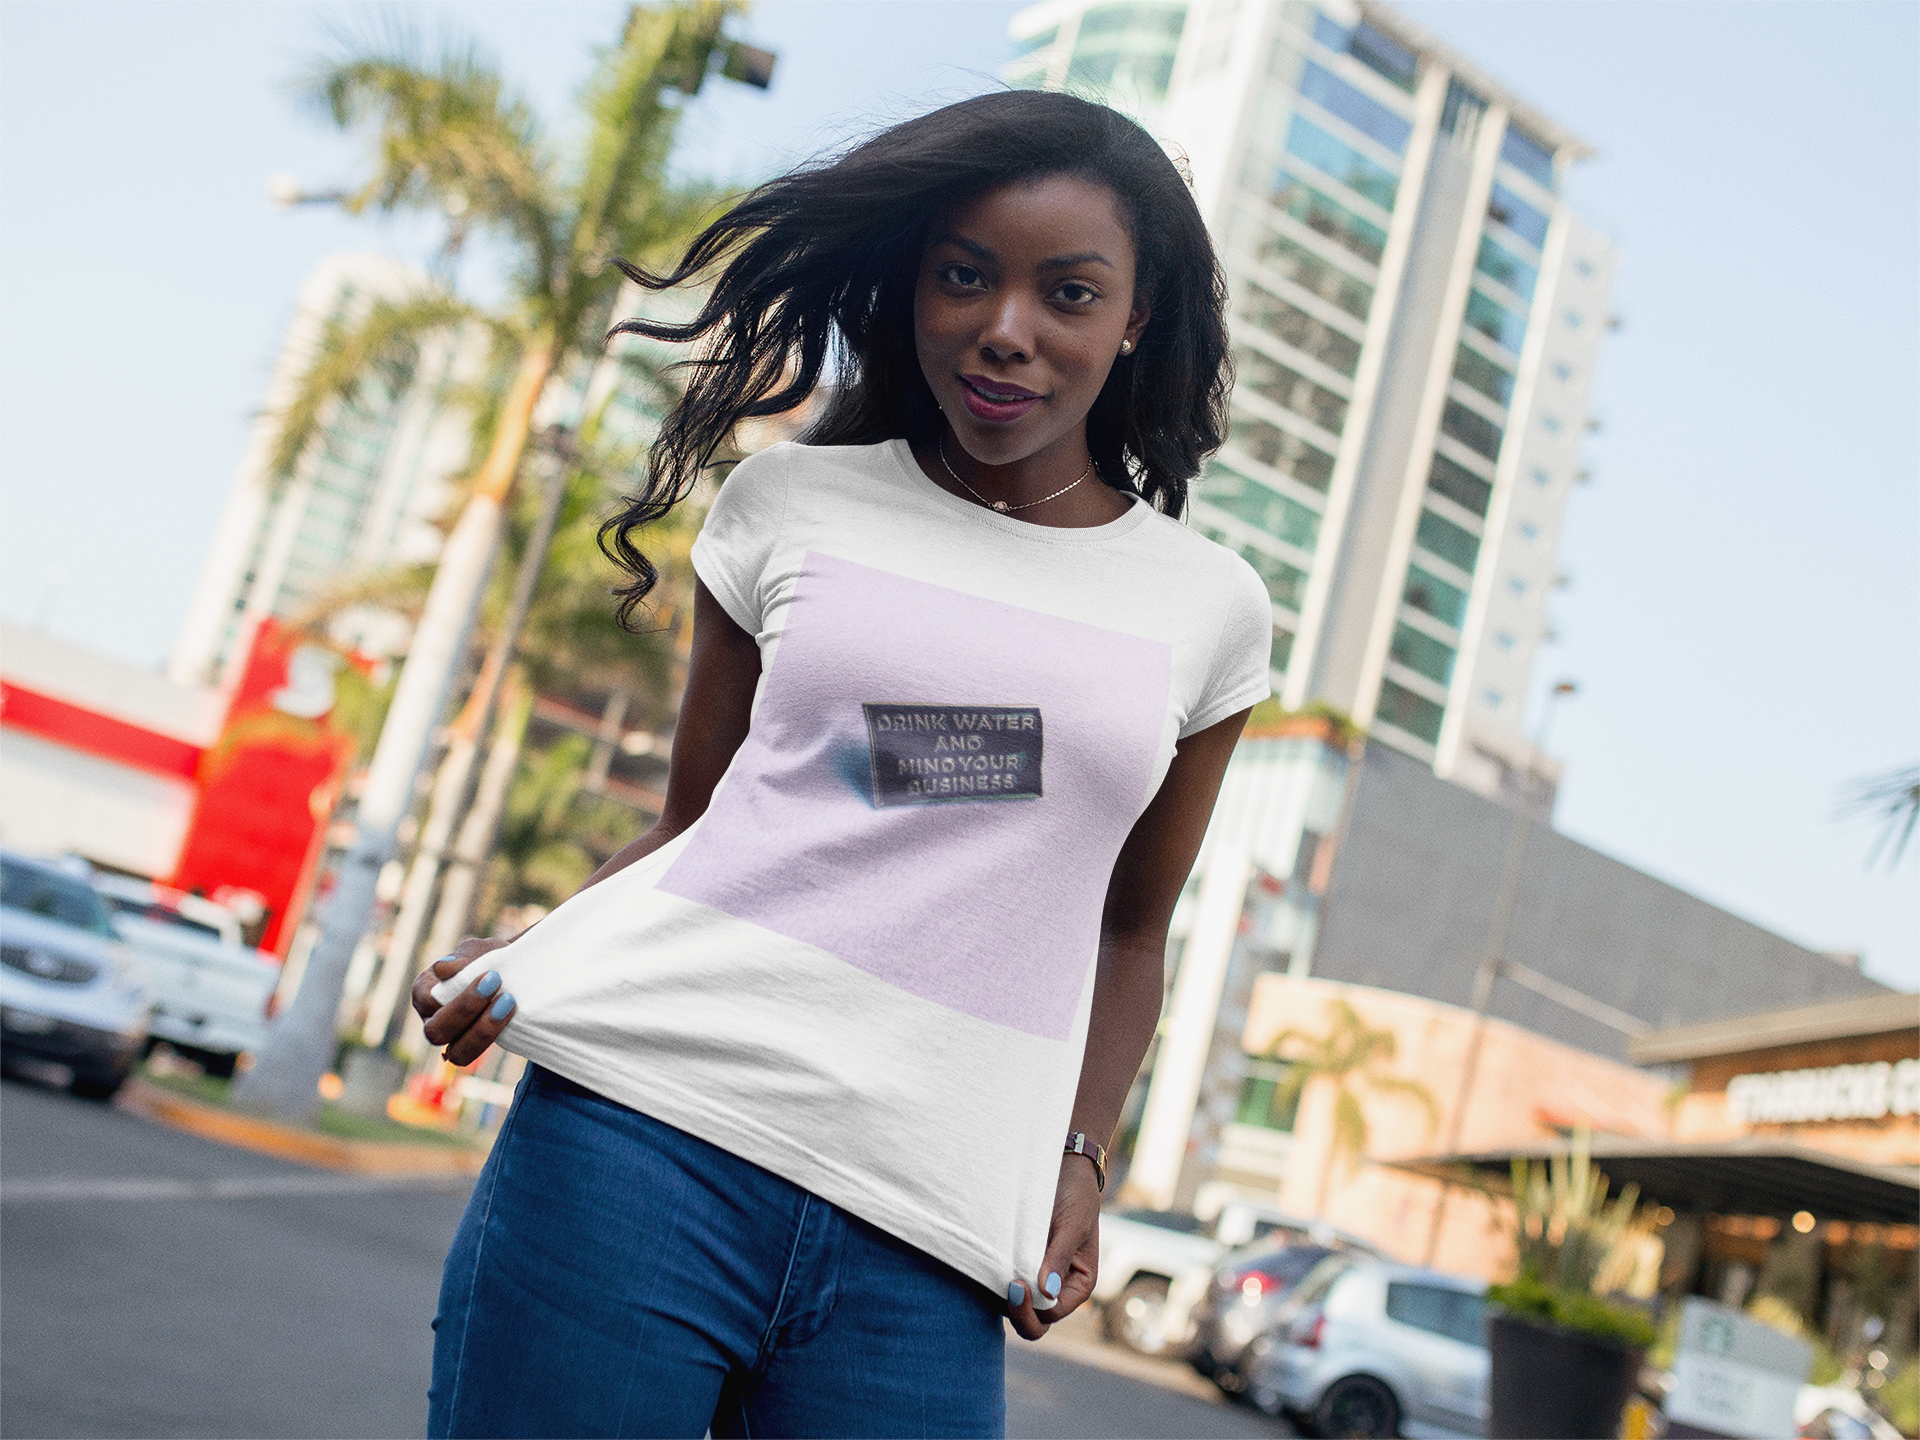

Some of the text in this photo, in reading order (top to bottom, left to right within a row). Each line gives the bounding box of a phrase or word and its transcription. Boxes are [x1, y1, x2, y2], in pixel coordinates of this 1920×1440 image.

[877, 713, 1035, 731] DRINK WATER
[934, 735, 984, 753] AND
[908, 774, 1015, 796] BUSINESS
